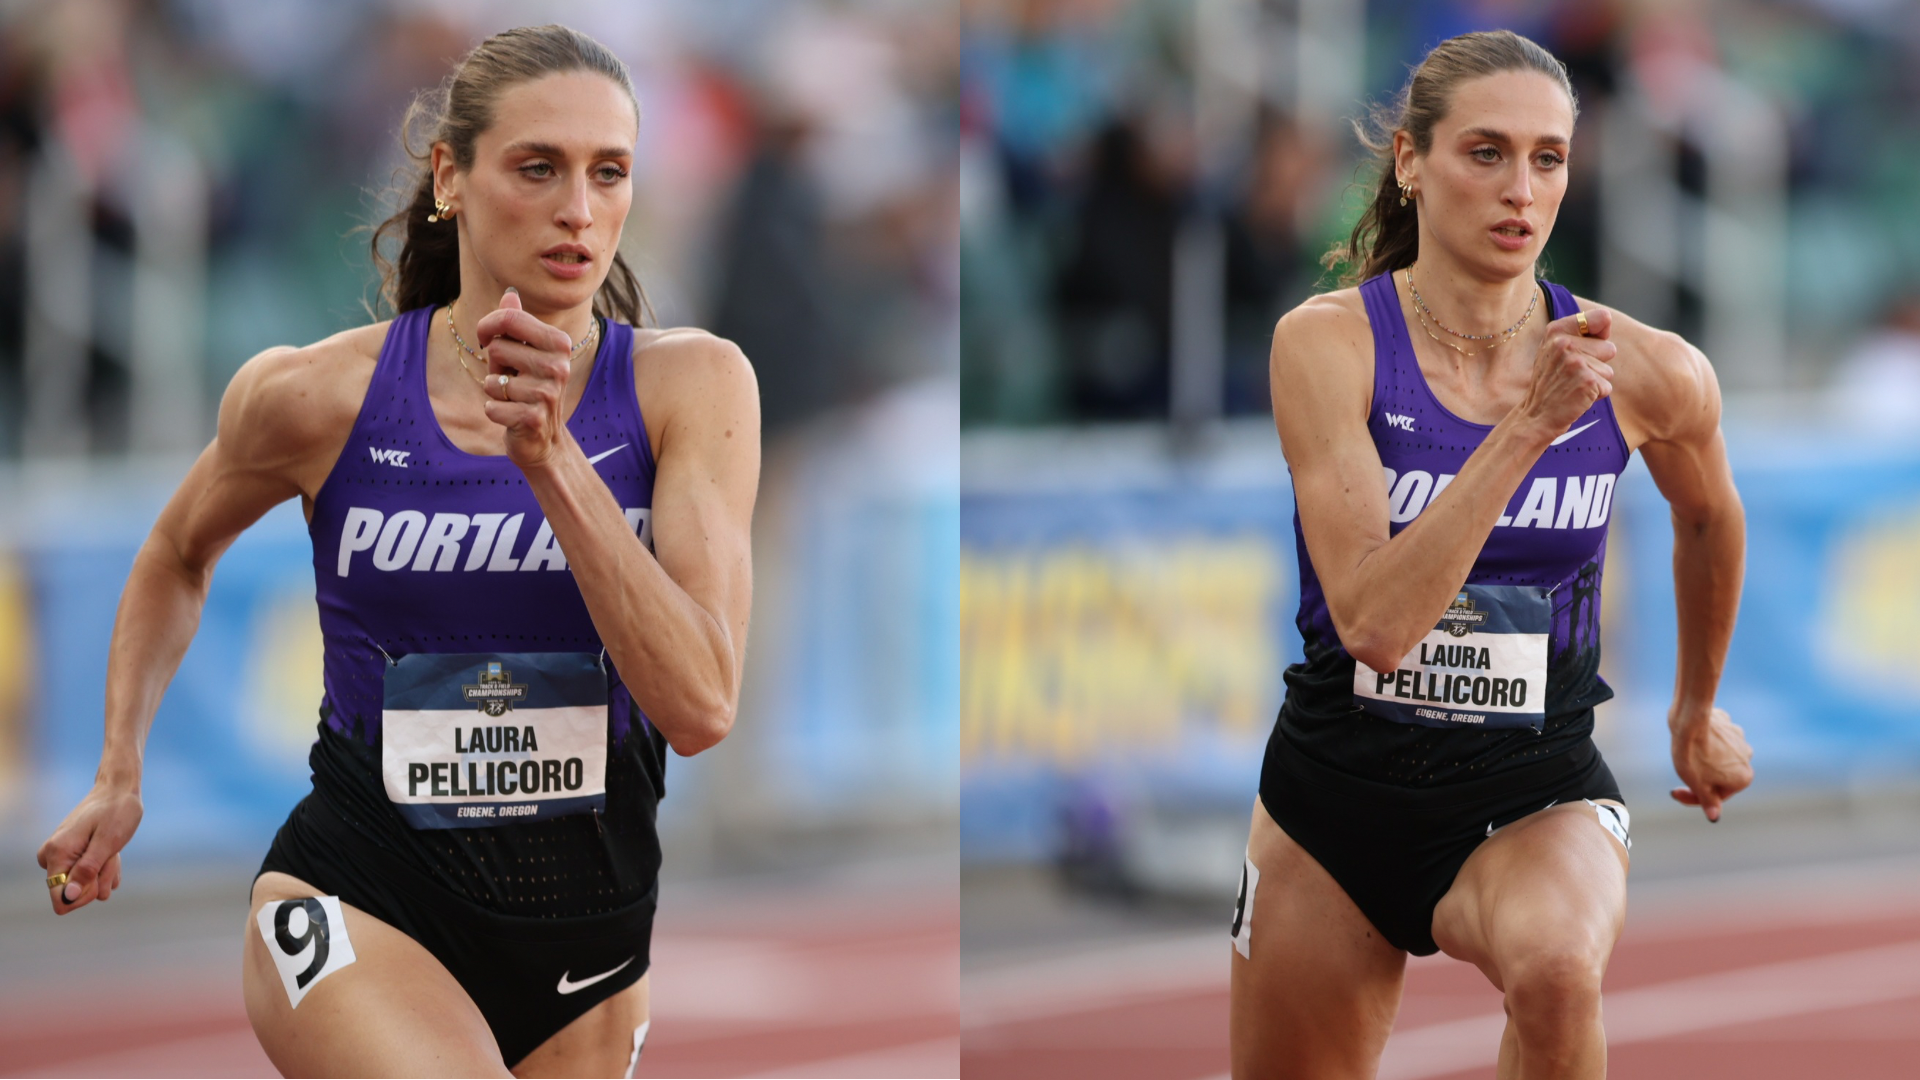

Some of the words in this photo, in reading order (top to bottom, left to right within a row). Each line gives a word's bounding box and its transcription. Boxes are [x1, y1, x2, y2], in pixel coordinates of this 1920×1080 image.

[1385, 412, 1415, 432] WCC
[369, 446, 411, 468] WCC
[1382, 466, 1616, 529] OAND
[337, 507, 653, 578] PORTLAD
[1443, 613, 1483, 622] AMPIONSHIPS
[1420, 643, 1491, 670] LAURA
[468, 688, 523, 698] CHAMPIONSHIPS
[1376, 669, 1527, 707] PELLICORO
[1415, 708, 1449, 721] EUGENE,
[1451, 713, 1486, 724] OREGON
[455, 726, 538, 754] LAURA
[408, 757, 584, 797] PELLICORO
[457, 806, 496, 818] EUGENE,
[499, 805, 538, 817] OREGON
[274, 897, 330, 990] 9
